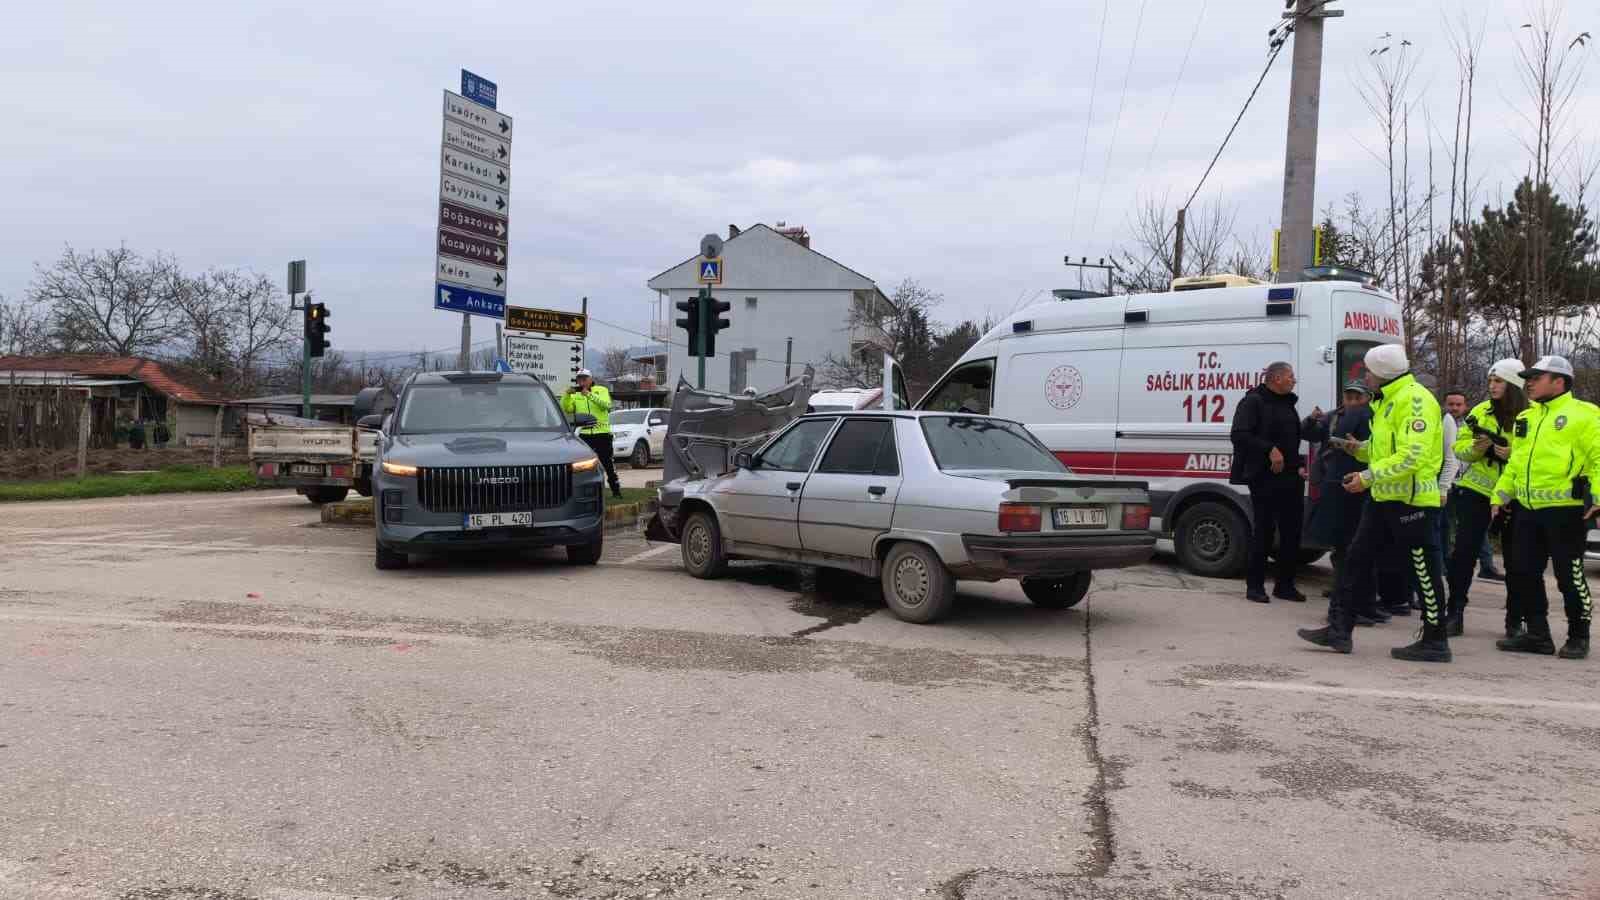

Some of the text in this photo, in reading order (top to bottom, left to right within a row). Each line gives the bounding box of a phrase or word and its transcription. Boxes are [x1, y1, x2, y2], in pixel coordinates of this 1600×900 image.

[443, 180, 488, 203] Çayyaka
[443, 207, 494, 231] Boğazova
[440, 233, 491, 257] Kocayayla
[440, 263, 470, 279] Keles
[466, 295, 505, 312] Ankara
[1344, 311, 1399, 336] AMBULANS
[1197, 351, 1222, 369] T.C.
[1146, 370, 1193, 391] SAĞLIK
[1182, 393, 1225, 423] 112
[1184, 453, 1233, 471] AMB
[471, 513, 531, 526] 16 PL 420
[1060, 511, 1069, 523] 16
